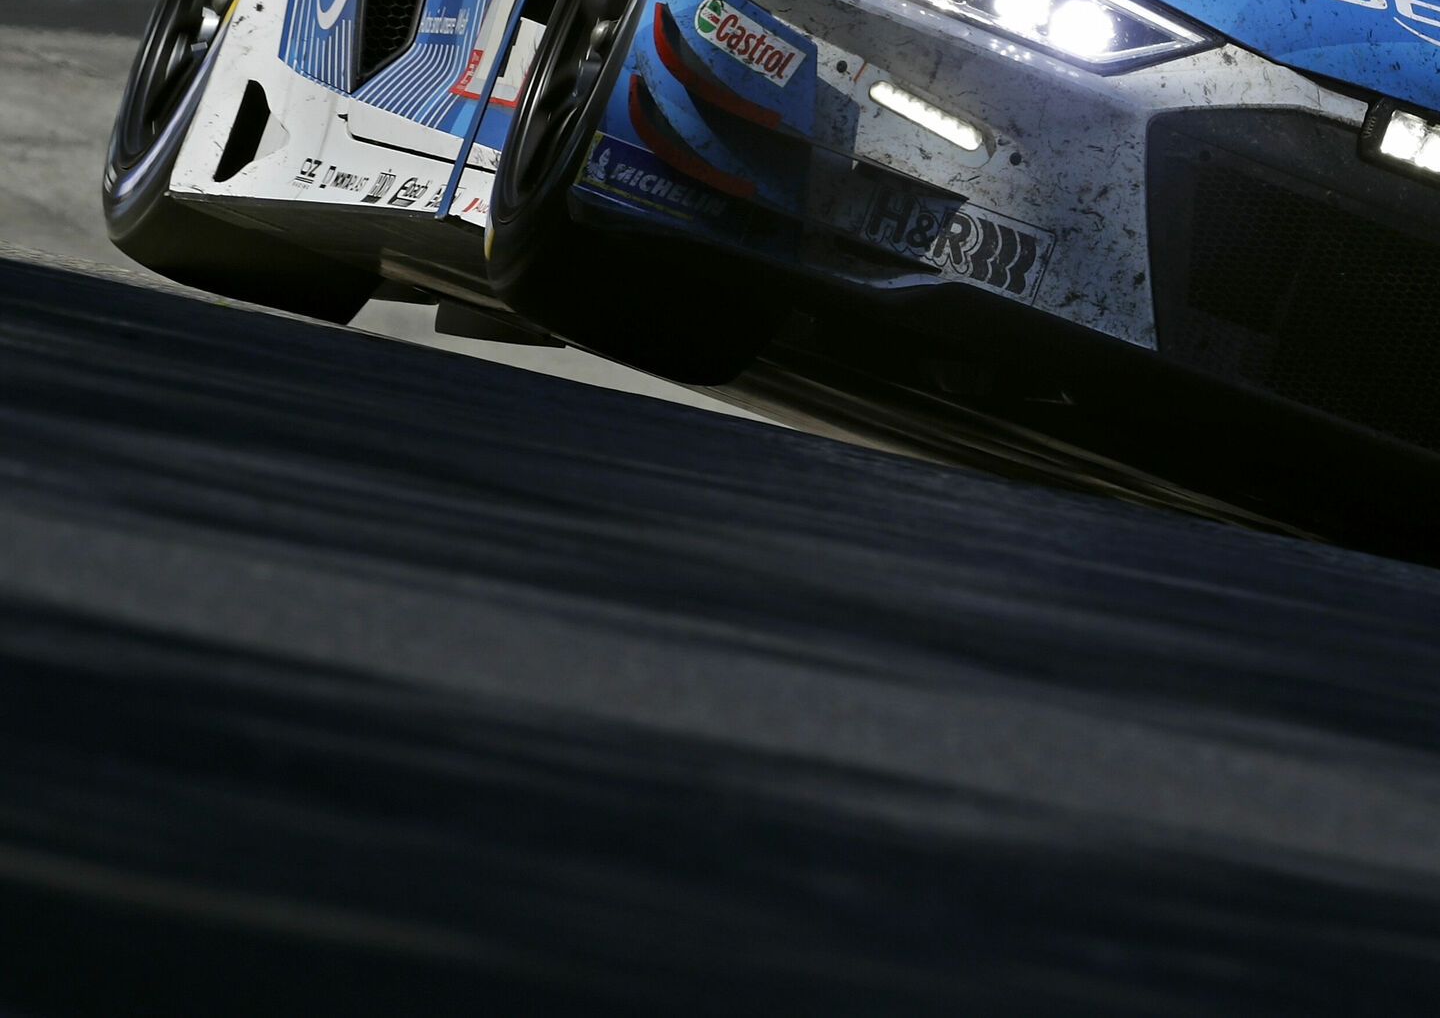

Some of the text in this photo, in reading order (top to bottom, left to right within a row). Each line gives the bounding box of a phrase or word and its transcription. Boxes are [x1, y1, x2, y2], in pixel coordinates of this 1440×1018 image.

[716, 13, 796, 79] Castrol
[610, 163, 727, 216] MICHELIN
[866, 185, 974, 267] H&R
